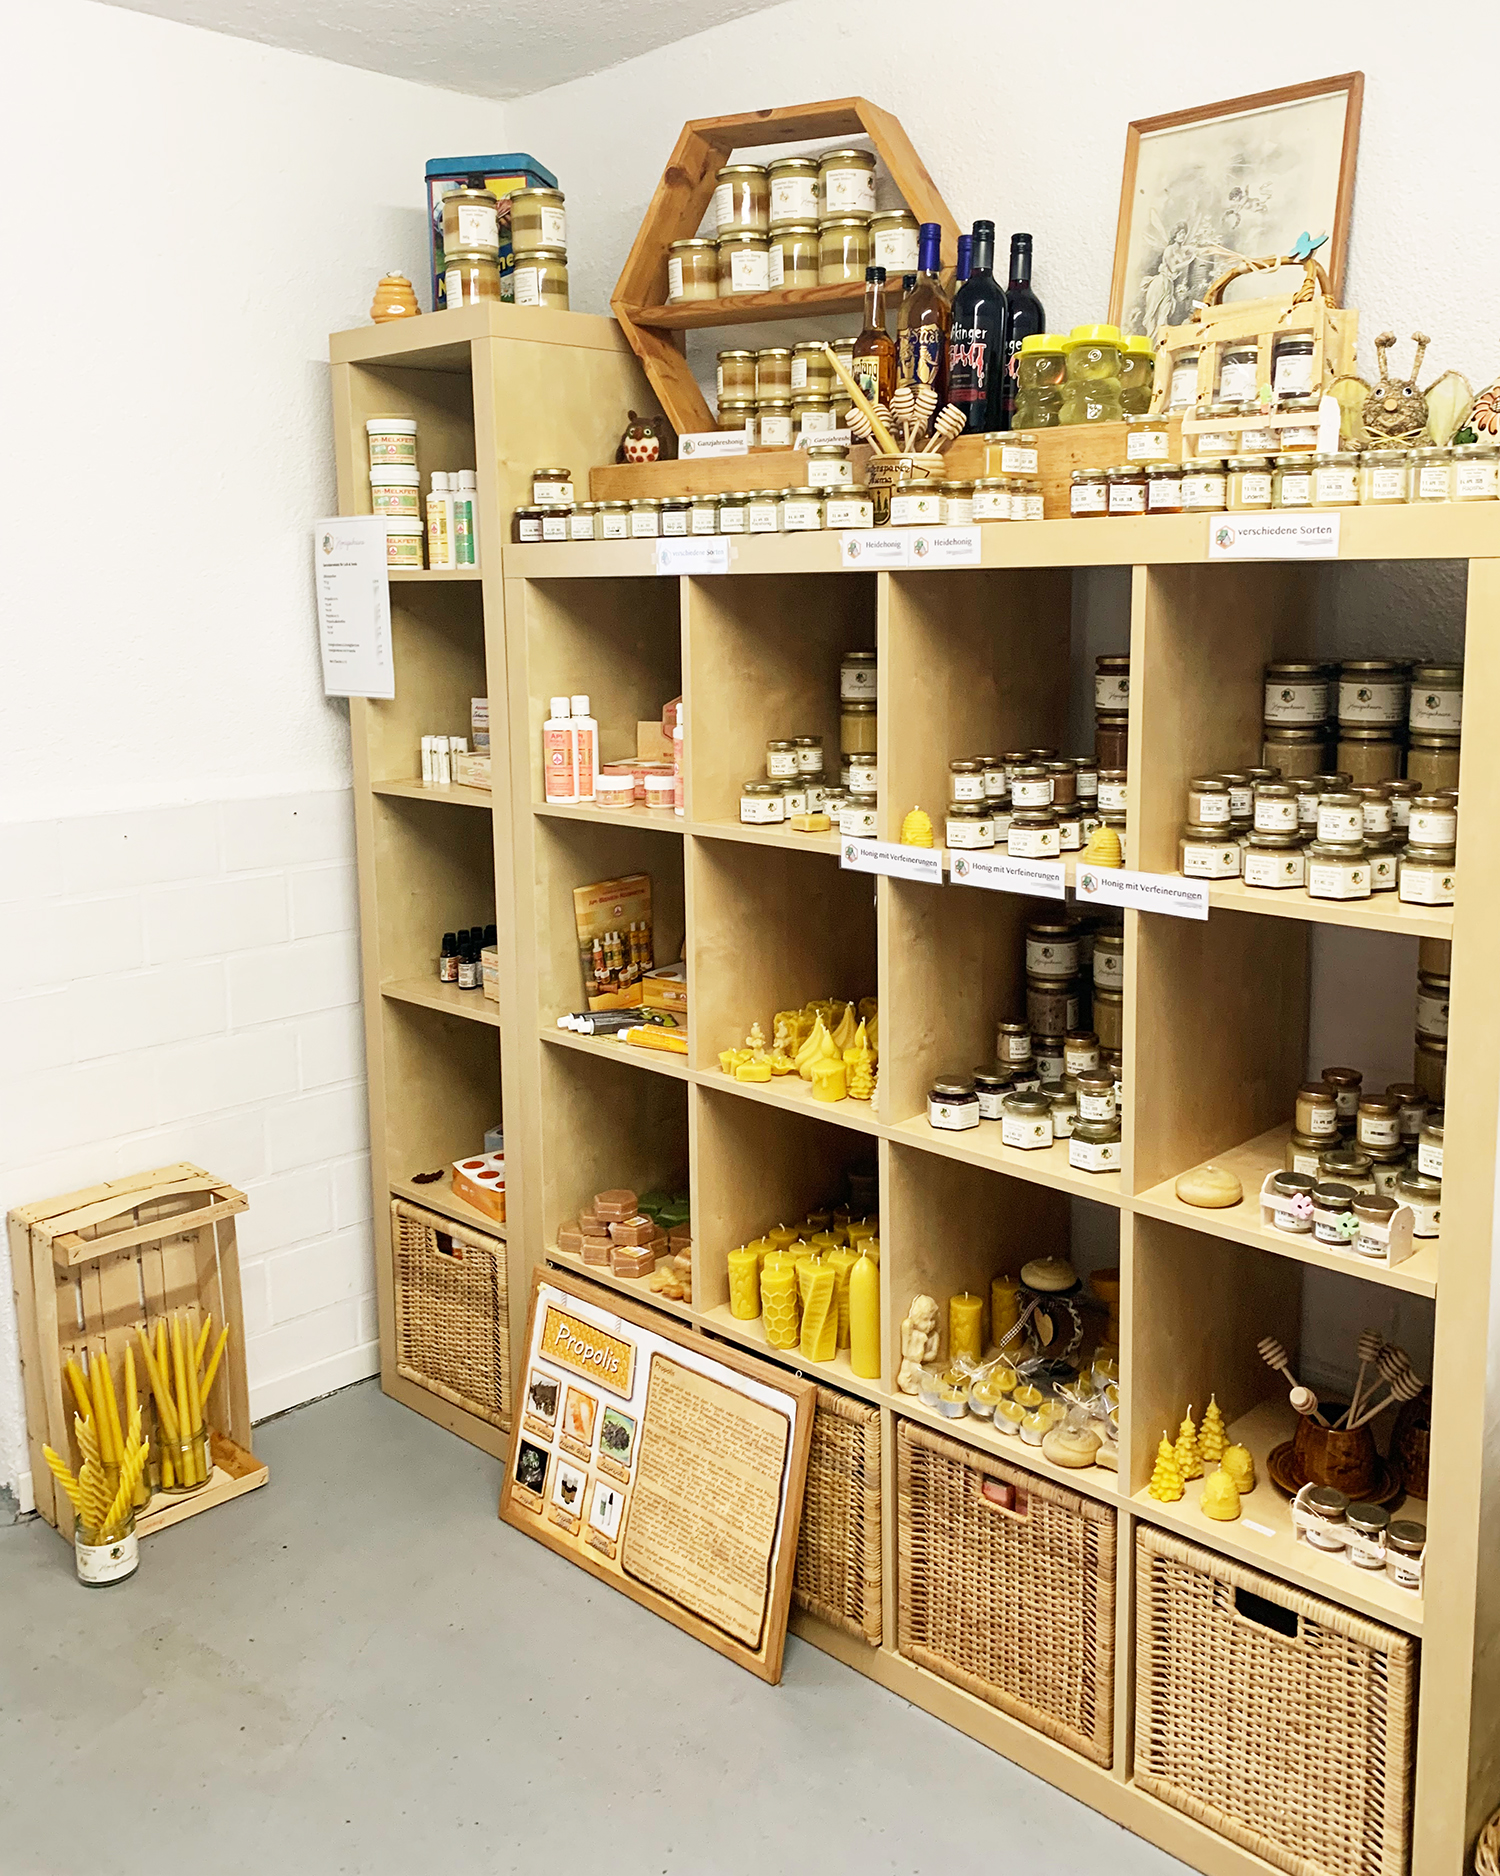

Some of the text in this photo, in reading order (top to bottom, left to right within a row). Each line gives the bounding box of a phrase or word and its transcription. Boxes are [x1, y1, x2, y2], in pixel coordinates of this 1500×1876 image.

[697, 438, 744, 448] Ganzjahreshonig
[1238, 525, 1332, 536] verschiedene Sorten
[865, 541, 902, 550] Heidehonig
[933, 538, 973, 547] Heidehonig
[672, 548, 725, 557] verschiedene Sorten
[860, 849, 938, 867] Honig mit Verfeinerungen
[972, 862, 993, 874] Honig
[1005, 867, 1060, 882] Verfeinerungen
[1101, 878, 1203, 900] Honig mit Verfeinerungen
[555, 1322, 620, 1374] Propolis
[655, 1360, 676, 1377] Propolis
